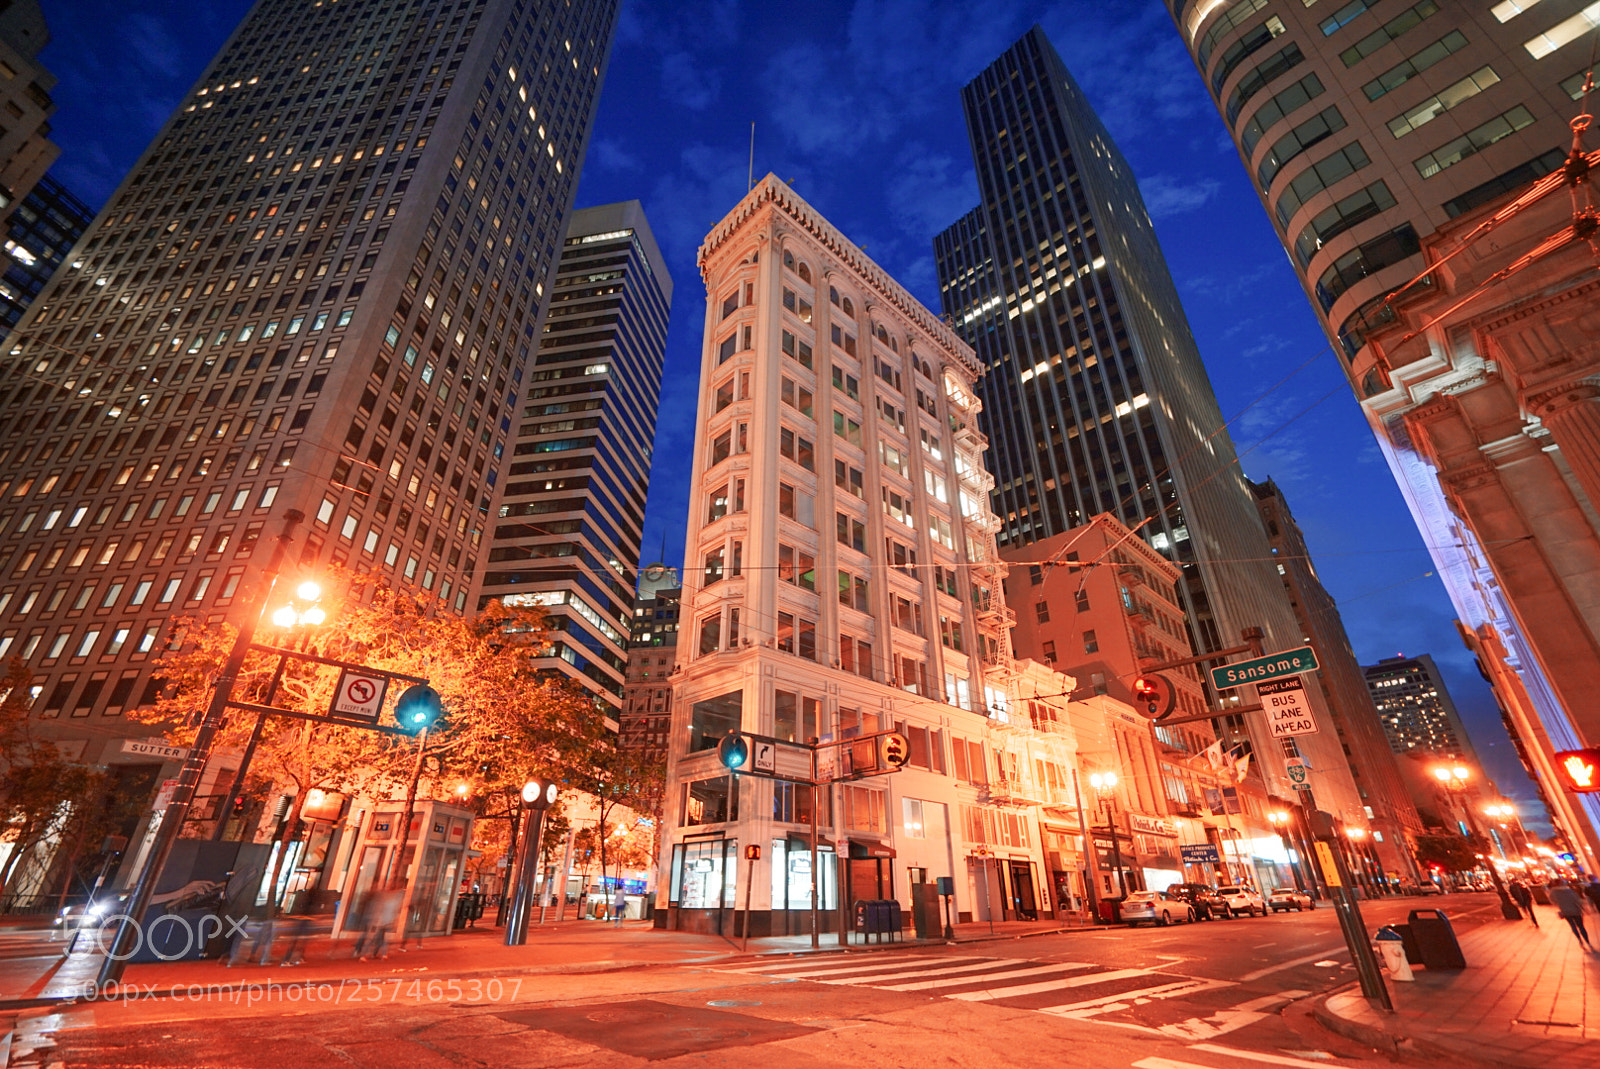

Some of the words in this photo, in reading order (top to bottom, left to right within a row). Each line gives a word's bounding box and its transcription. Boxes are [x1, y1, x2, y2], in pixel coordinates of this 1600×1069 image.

[1227, 657, 1300, 681] Sansome
[1259, 683, 1278, 693] RIGHT
[1280, 680, 1300, 689] LANE
[1272, 694, 1296, 707] BUS
[1273, 707, 1304, 721] LANE
[1275, 719, 1312, 734] AHEAD
[131, 744, 180, 757] SUTTER
[757, 759, 772, 768] ONLY
